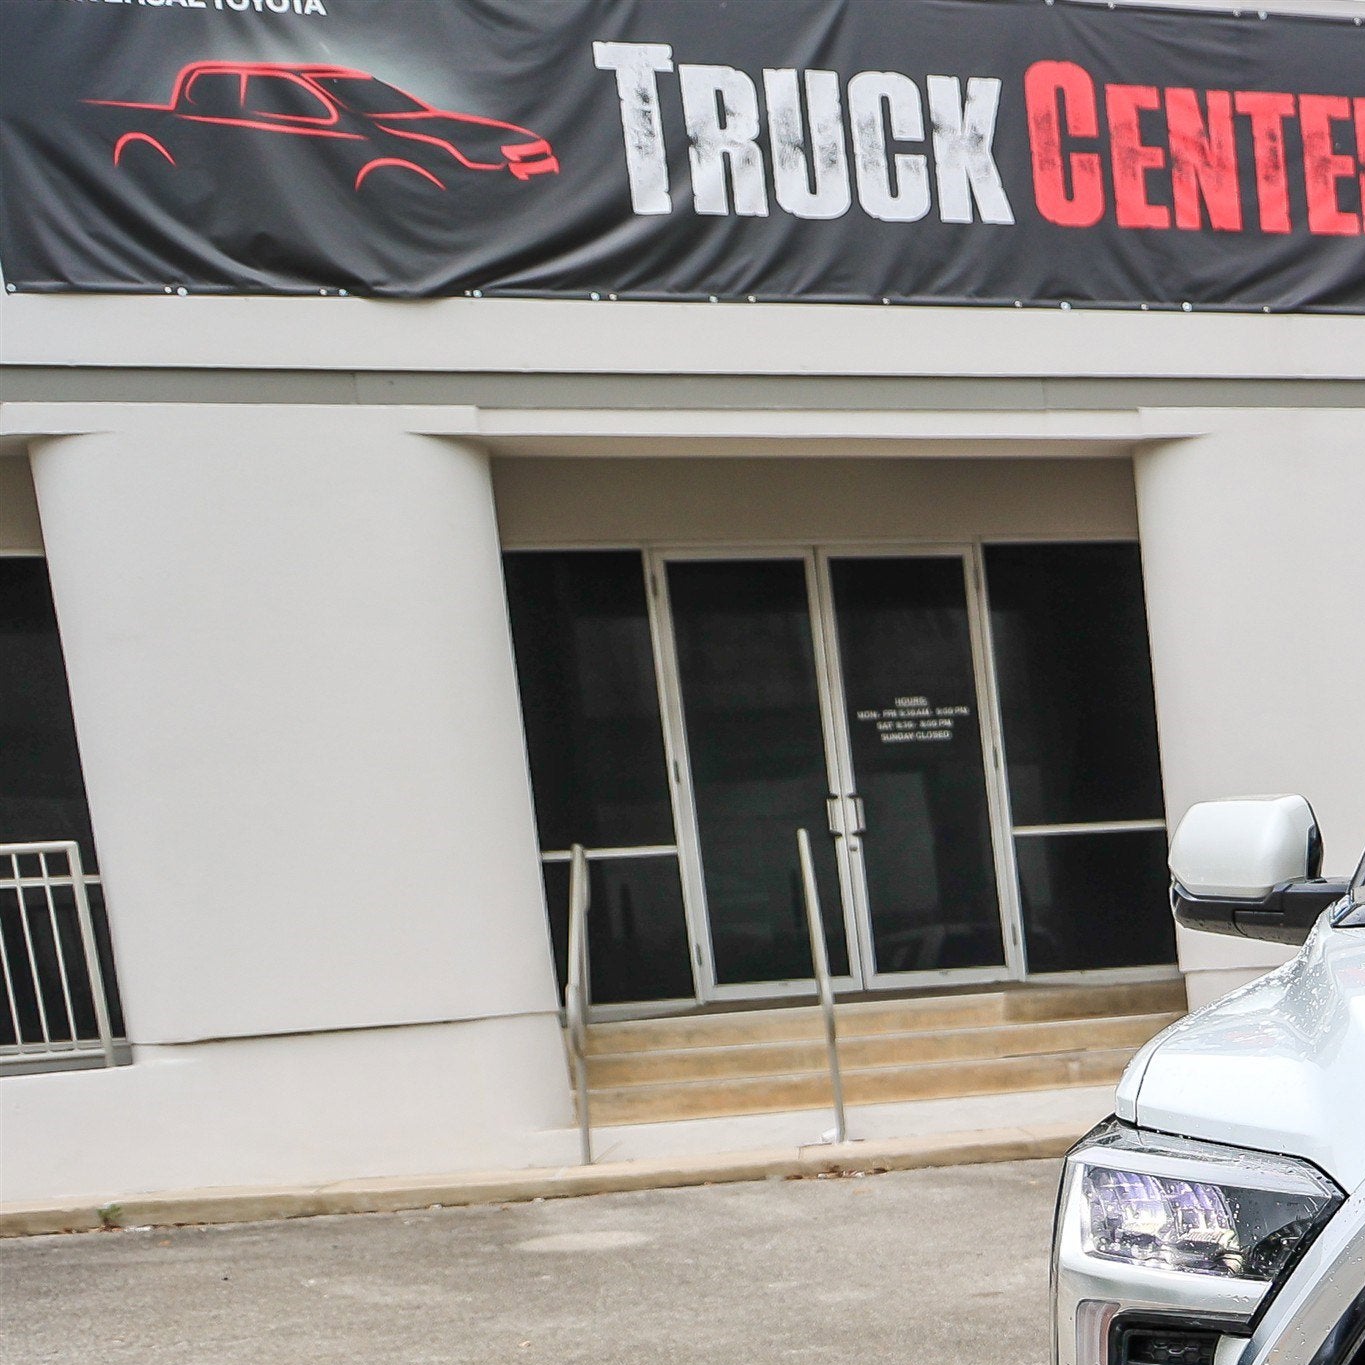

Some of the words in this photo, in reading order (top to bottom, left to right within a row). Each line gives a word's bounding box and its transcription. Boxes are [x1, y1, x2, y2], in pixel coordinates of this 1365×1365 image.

[592, 41, 1015, 225] TRUCK
[880, 731, 914, 741] SUNDAY
[915, 730, 952, 740] CLOSED
